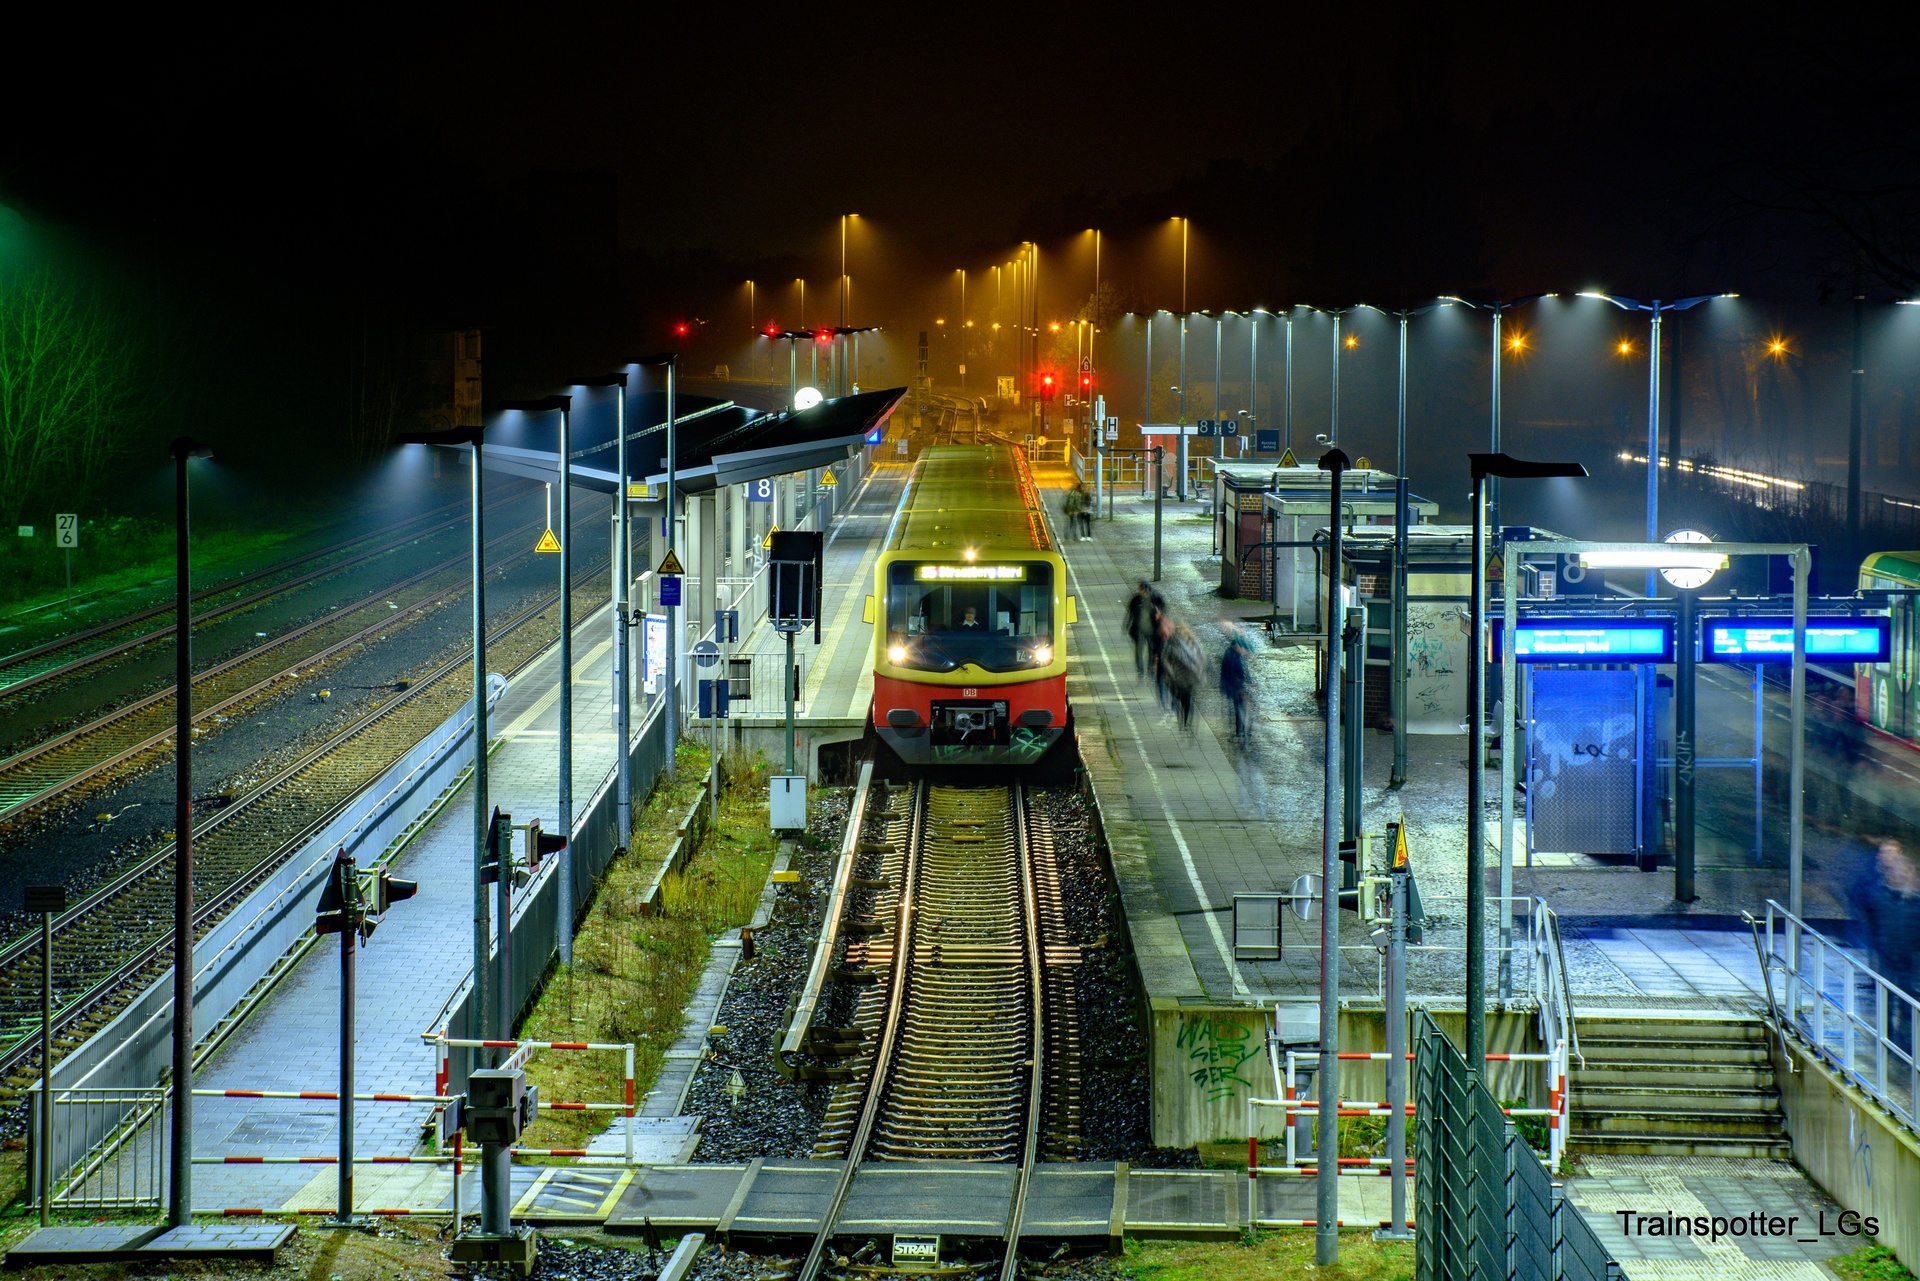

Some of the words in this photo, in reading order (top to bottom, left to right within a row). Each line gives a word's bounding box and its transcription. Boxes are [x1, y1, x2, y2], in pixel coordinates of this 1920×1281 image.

[1083, 361, 1089, 371] 6
[1107, 418, 1117, 431] H
[1200, 420, 1208, 433] 8
[1227, 420, 1236, 433] 9
[758, 479, 770, 497] 8
[59, 516, 75, 529] 27
[62, 531, 72, 544] 6
[1563, 552, 1586, 583] 8
[963, 689, 977, 697] DB
[894, 1244, 937, 1255] STRAIL
